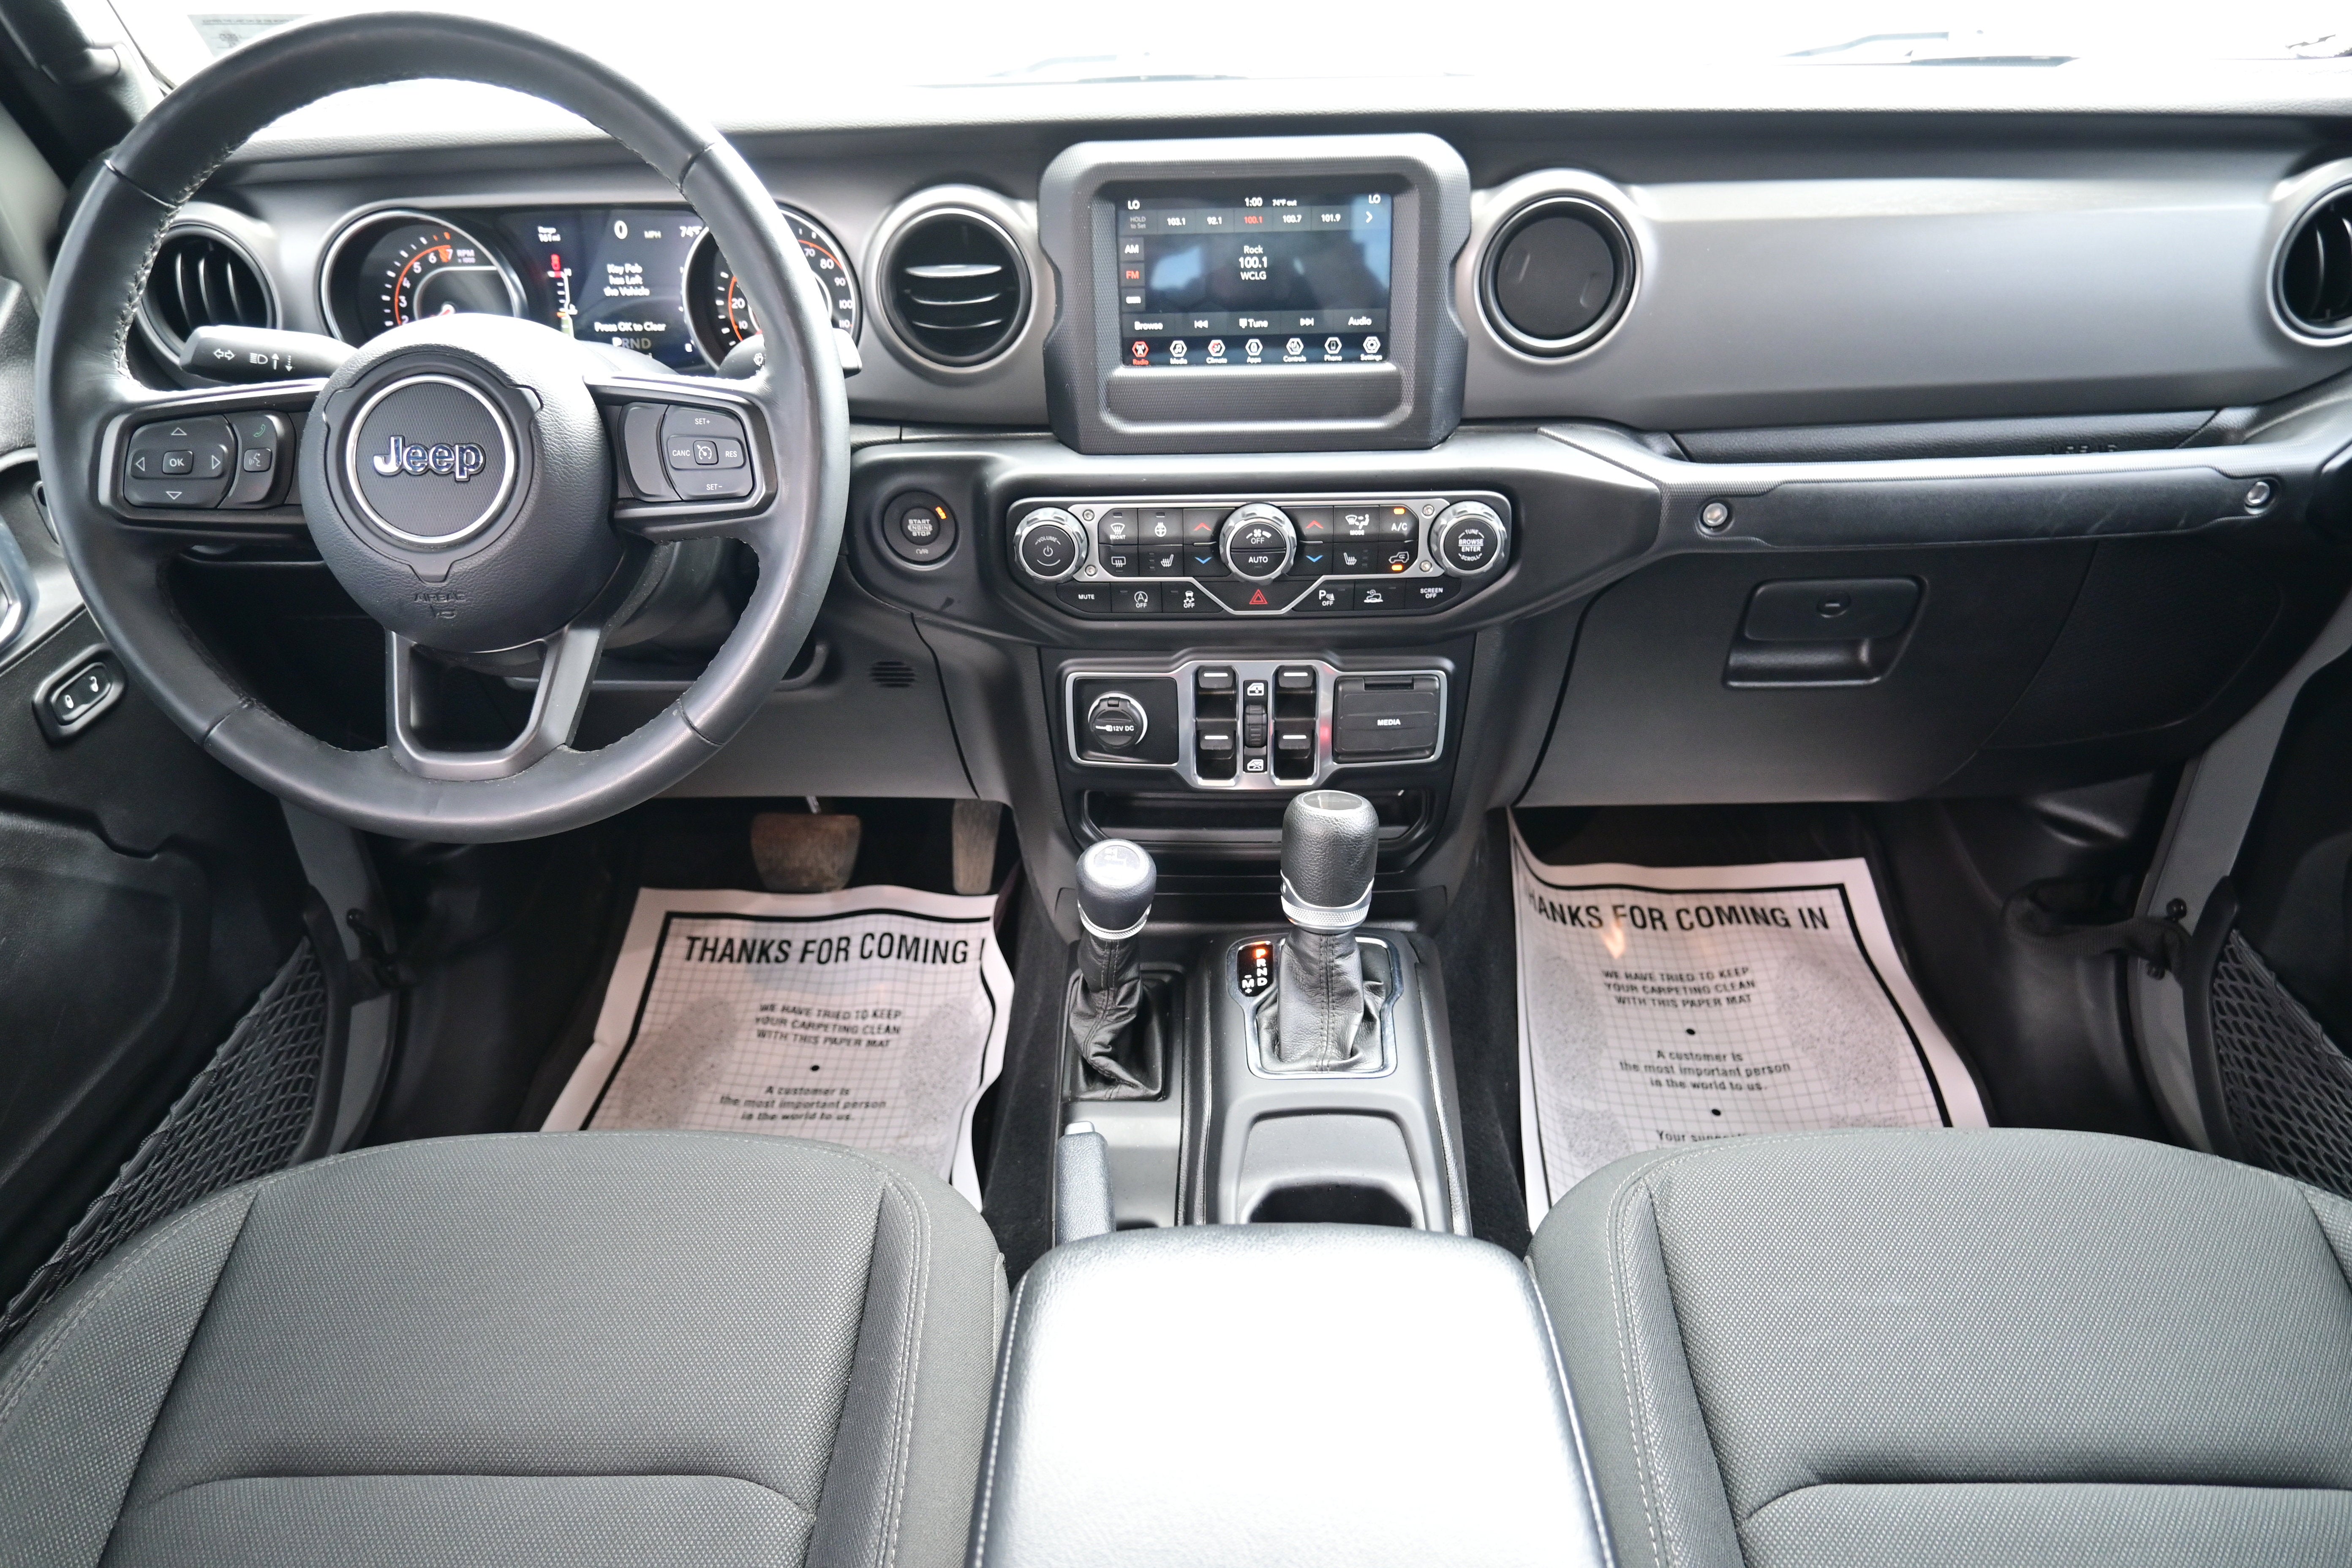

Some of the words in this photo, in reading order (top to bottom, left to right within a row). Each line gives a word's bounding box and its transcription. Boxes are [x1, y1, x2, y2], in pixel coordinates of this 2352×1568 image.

[1244, 197, 1263, 207] 1:00
[1369, 194, 1380, 204] LO
[1127, 200, 1141, 210] LO
[1167, 218, 1186, 226] 103.1
[1207, 217, 1222, 225] 92.1
[1244, 216, 1263, 224] 100.1
[1282, 215, 1302, 223] 100.7
[1321, 213, 1341, 222] 101.9
[803, 248, 815, 257] 70
[1124, 245, 1139, 253] AM
[1244, 245, 1263, 254] Rock
[428, 252, 437, 264] 6
[1239, 256, 1267, 269] 100.1
[413, 261, 422, 274] 5
[819, 259, 834, 270] 80
[1126, 270, 1140, 279] FM
[1240, 271, 1266, 280] WCLG
[834, 277, 846, 286] 90
[398, 295, 407, 308] 3
[731, 298, 745, 309] 20
[839, 299, 852, 309] 100
[1248, 319, 1269, 328] Tune
[1348, 316, 1372, 326] Audio
[617, 322, 633, 332] OK
[169, 458, 185, 467] OK
[373, 435, 486, 482] Jeep
[1391, 523, 1407, 531] A/C
[1612, 904, 1668, 931] FOR
[1676, 905, 1791, 931] COMING
[1797, 906, 1829, 930] IN
[685, 936, 792, 964] THANKS
[800, 936, 851, 965] FOR
[860, 933, 969, 964] COMING
[1255, 948, 1266, 958] P
[1256, 958, 1267, 967] R
[1257, 967, 1268, 977] N
[1603, 970, 1619, 979] WE
[1625, 971, 1655, 981] HAVE
[1660, 973, 1695, 982] TRIED
[1699, 972, 1715, 981] TO
[1718, 967, 1748, 977] KEEP
[1242, 979, 1255, 988] M
[1257, 977, 1268, 986] D
[1604, 982, 1638, 992] YOUR
[1642, 985, 1711, 994] CARPETING
[1714, 980, 1756, 992] CLEAN
[1615, 996, 1647, 1005] WITH
[1651, 998, 1678, 1008] THIS
[1681, 998, 1723, 1008] PAPER
[1726, 994, 1751, 1004] MAT
[760, 1003, 776, 1012] WE
[781, 1005, 813, 1016] HAVE
[817, 1010, 852, 1020] TRIED
[855, 1010, 868, 1020] TO
[872, 1009, 902, 1019] KEEP
[755, 1016, 788, 1026] YOUR
[791, 1019, 859, 1032] CARPETING
[862, 1024, 901, 1034] CLEAN
[757, 1029, 789, 1040] WITH
[793, 1034, 819, 1045] THIS
[823, 1037, 862, 1046] PAPER
[866, 1040, 890, 1048] MAT
[1657, 1050, 1666, 1059] A
[1669, 1051, 1727, 1062] customer
[1732, 1052, 1743, 1062] is
[1620, 1061, 1640, 1072] the
[1644, 1064, 1675, 1074] most
[1679, 1065, 1742, 1076] important
[1745, 1062, 1791, 1078] person
[1650, 1078, 1663, 1087] in
[1666, 1078, 1687, 1089] the
[1690, 1080, 1726, 1090] world
[1729, 1082, 1743, 1091] to
[765, 1086, 775, 1095] A
[778, 1087, 836, 1096] customer
[720, 1096, 740, 1105] the
[743, 1100, 776, 1108] most
[779, 1100, 840, 1109] important
[843, 1100, 887, 1109] person
[1656, 1129, 1686, 1142] Your
